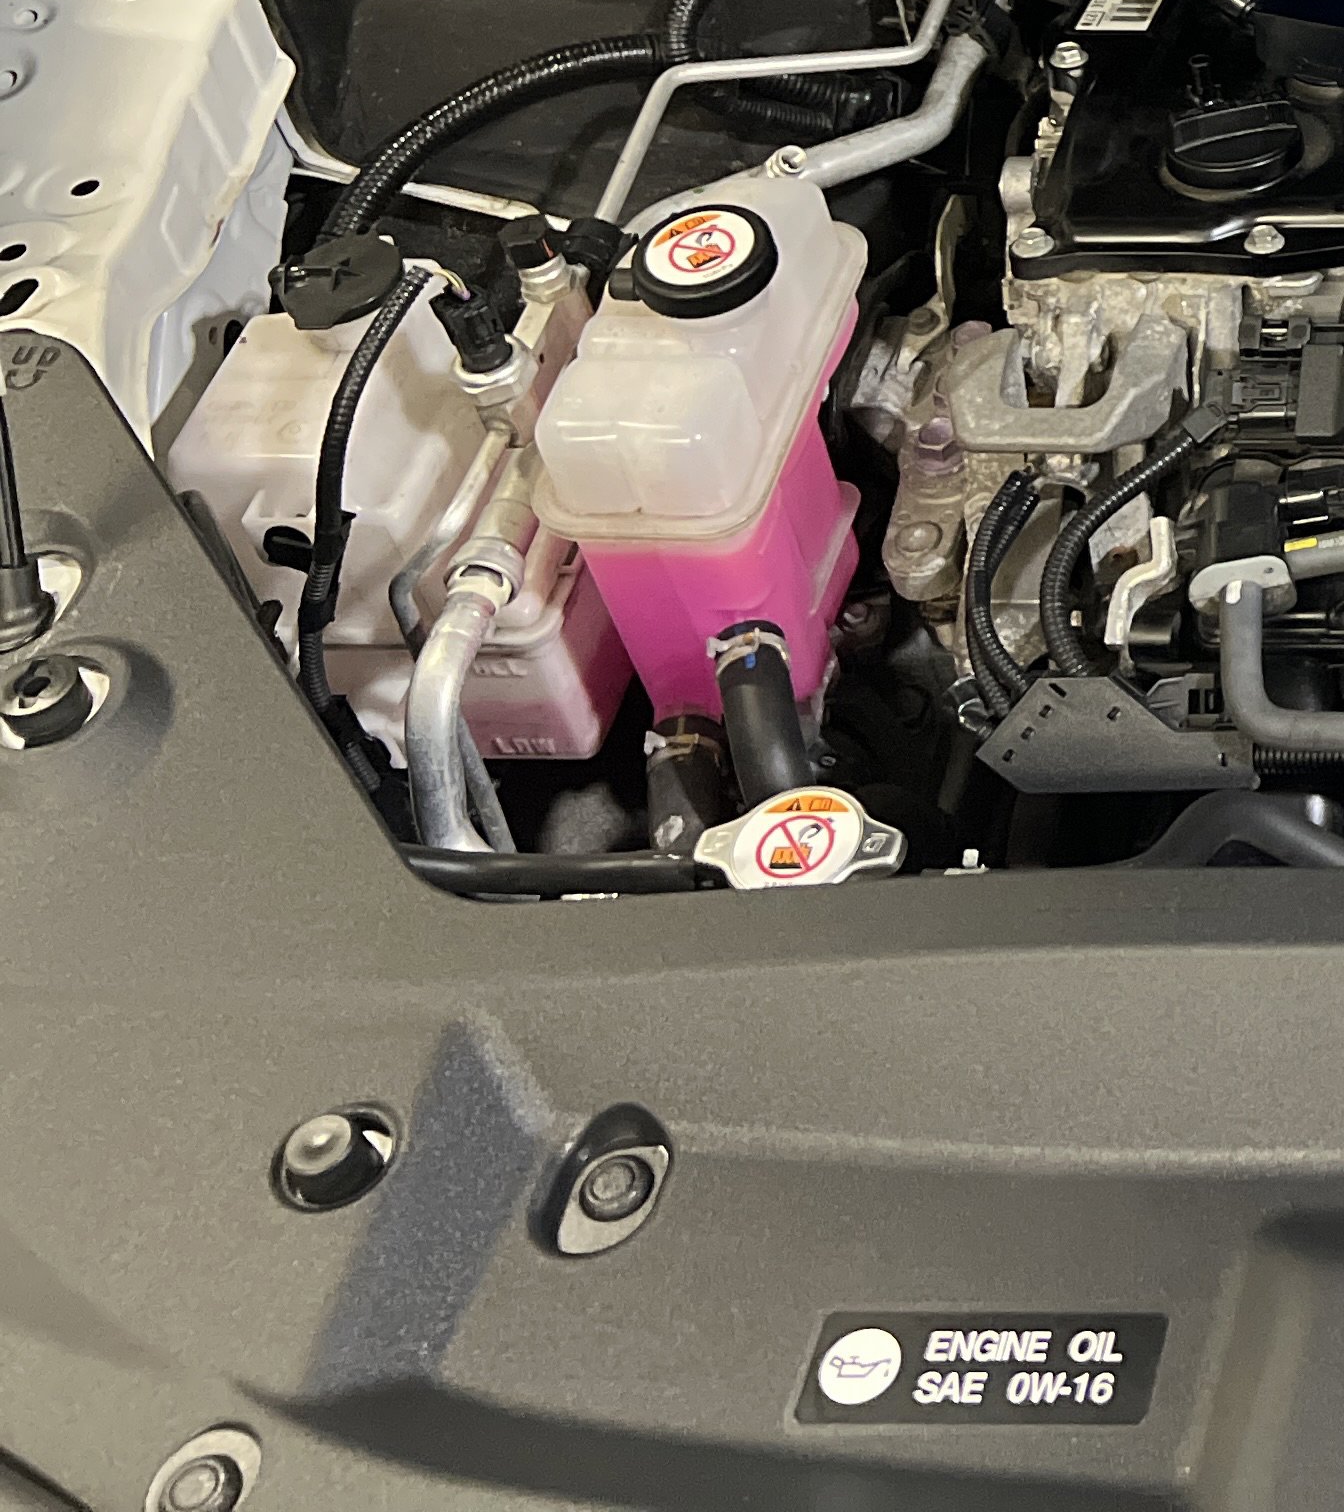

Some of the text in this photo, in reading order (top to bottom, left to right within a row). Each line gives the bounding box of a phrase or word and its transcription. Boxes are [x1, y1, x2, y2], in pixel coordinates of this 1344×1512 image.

[472, 658, 528, 677] ULL
[923, 1330, 1124, 1363] ENGINE OIL
[912, 1371, 1116, 1405] SAE 0W-16
